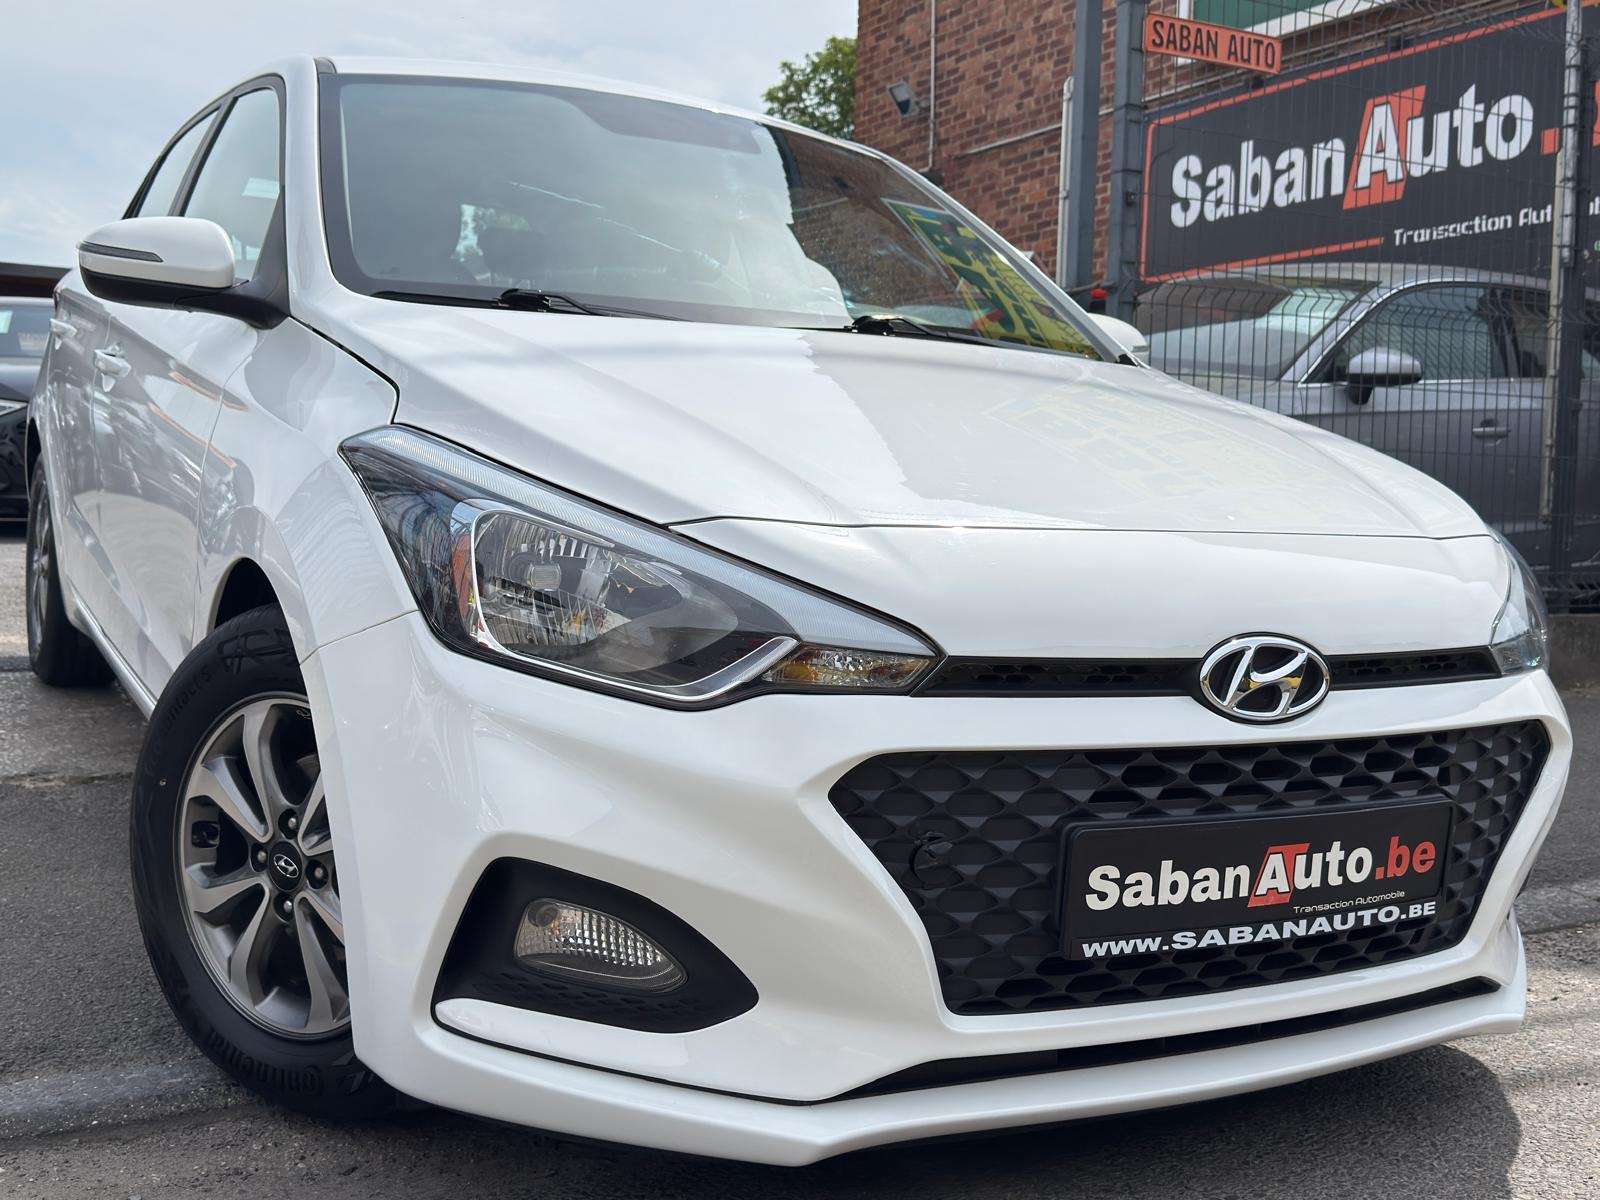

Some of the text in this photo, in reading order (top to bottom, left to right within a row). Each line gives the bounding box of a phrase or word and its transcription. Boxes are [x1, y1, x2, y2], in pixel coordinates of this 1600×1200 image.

[1151, 19, 1277, 70] SABAN AUTO
[1170, 80, 1600, 228] SabanAuto.
[1394, 214, 1513, 246] Transaction
[1085, 835, 1437, 912] SabanAuto.be
[1293, 890, 1406, 915] Transaction Automobile
